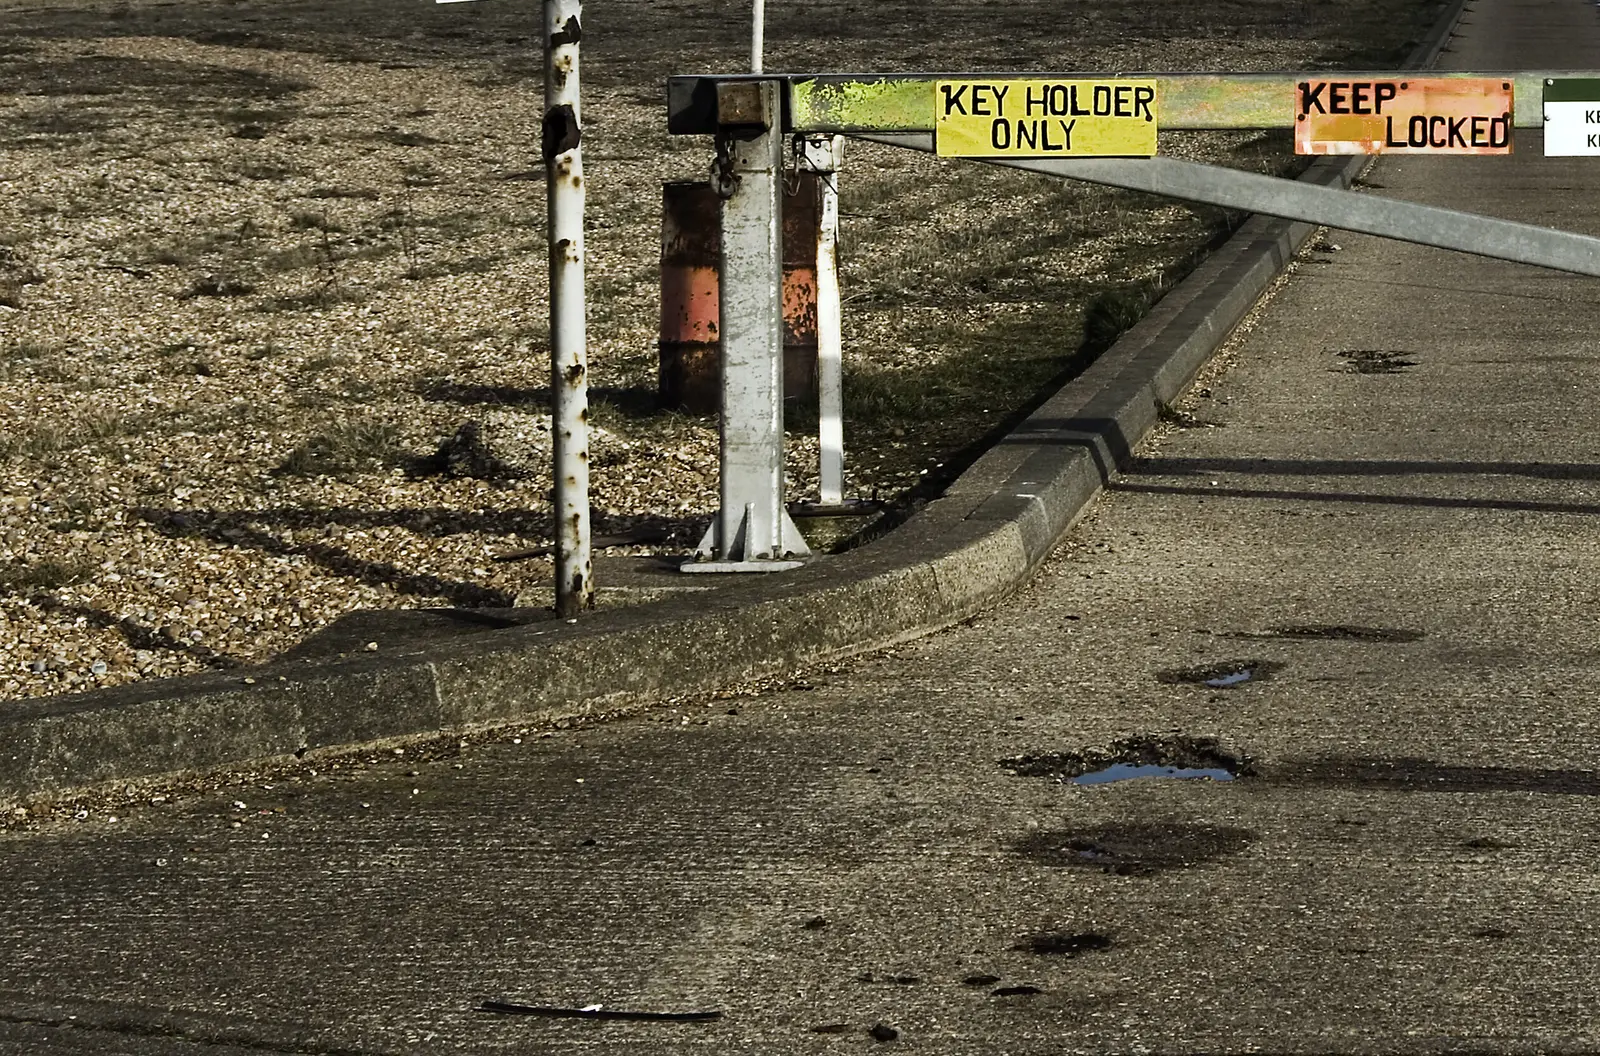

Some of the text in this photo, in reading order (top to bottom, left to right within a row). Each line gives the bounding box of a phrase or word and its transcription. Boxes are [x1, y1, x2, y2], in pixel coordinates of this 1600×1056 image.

[943, 85, 1154, 117] KEY HOLDER
[1301, 82, 1396, 114] KEEP
[991, 118, 1076, 150] ONLY
[1386, 115, 1510, 148] LOCKED
